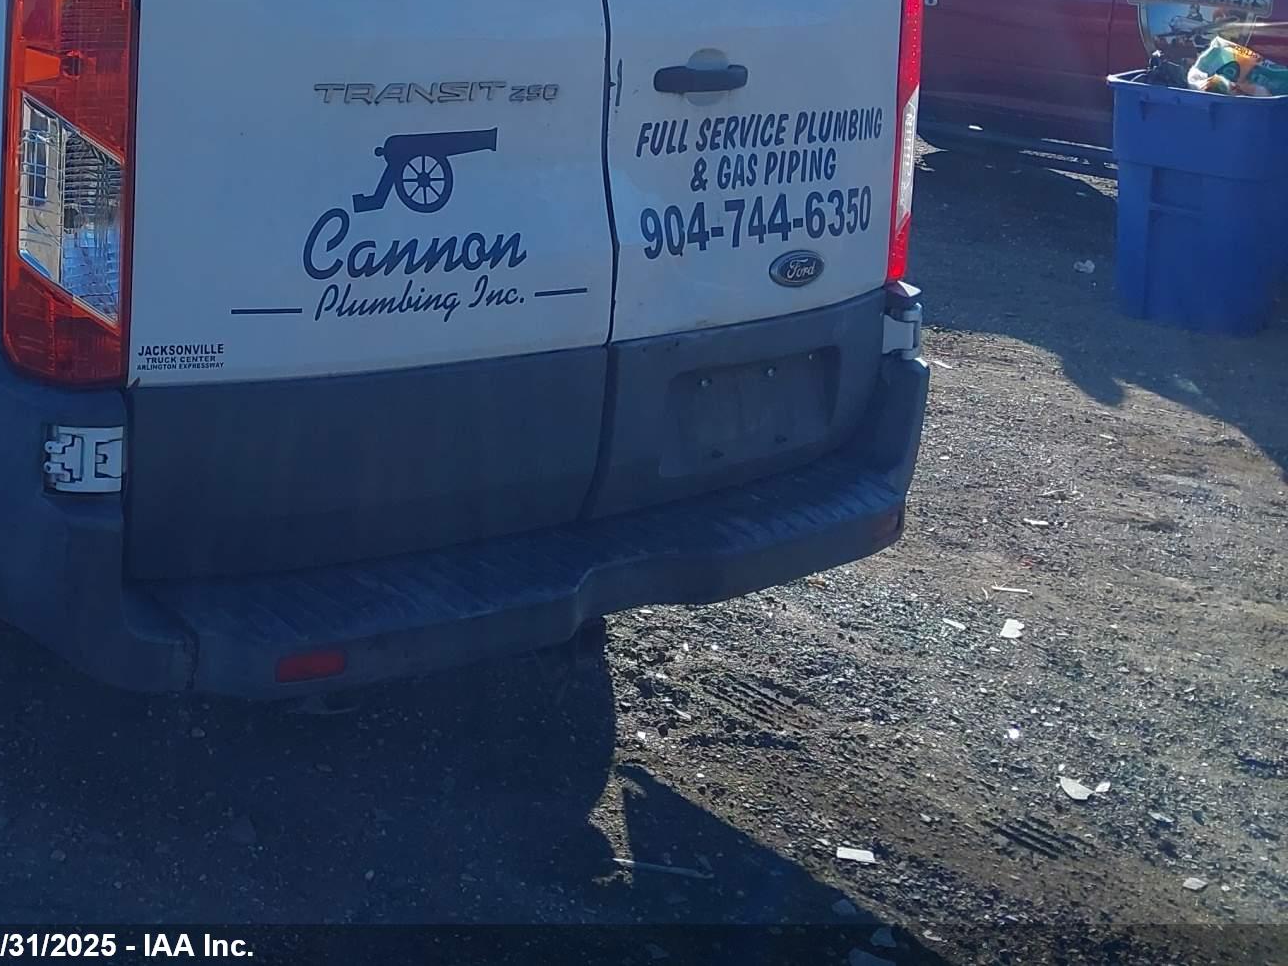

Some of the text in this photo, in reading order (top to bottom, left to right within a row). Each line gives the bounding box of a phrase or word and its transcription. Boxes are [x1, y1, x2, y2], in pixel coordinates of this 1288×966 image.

[314, 81, 560, 105] TRANSIT 250
[636, 107, 883, 158] FULL SERVICE PLUMBING
[690, 147, 837, 192] & GAS PIPING
[303, 208, 527, 280] Cannon
[639, 185, 872, 260] 904-744-6350
[786, 258, 817, 280] Ford
[314, 275, 525, 322] Plumbing Inc.
[138, 344, 224, 356] JACKSONVILLE
